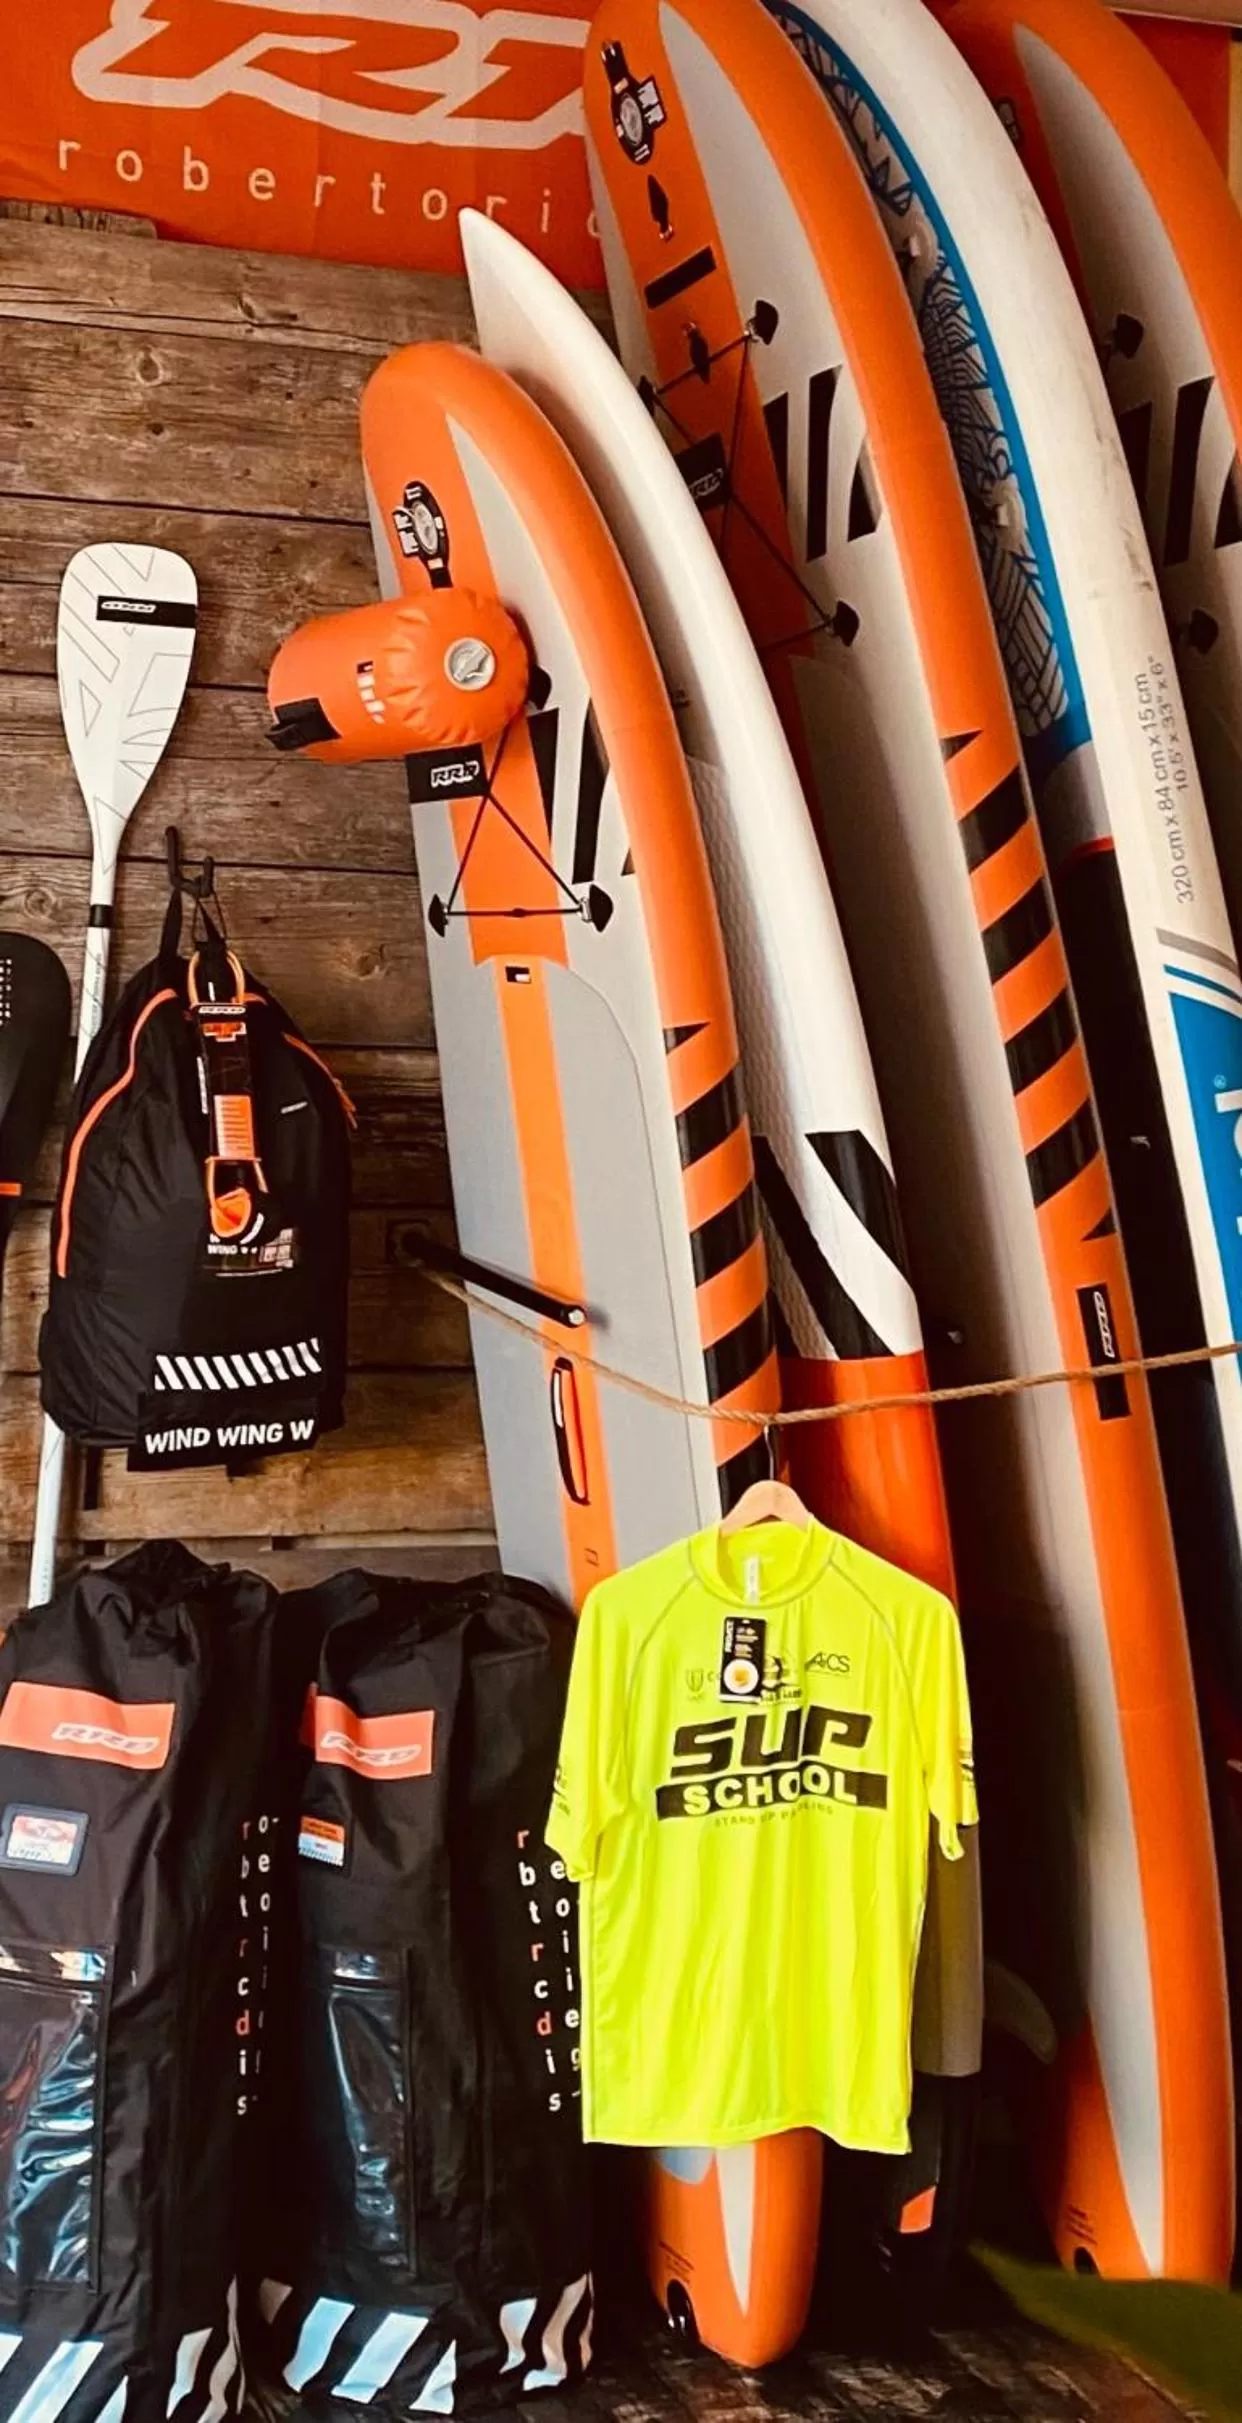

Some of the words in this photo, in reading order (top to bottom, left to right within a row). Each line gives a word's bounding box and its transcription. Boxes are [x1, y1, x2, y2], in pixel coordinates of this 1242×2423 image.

[1135, 672, 1152, 704] cm
[1138, 708, 1157, 732] 15
[1148, 734, 1162, 746] x
[1151, 750, 1168, 782] cm
[1155, 785, 1175, 811] 84
[1164, 815, 1179, 826] x
[1168, 830, 1185, 861] cm
[1171, 865, 1195, 904] 320
[145, 1427, 211, 1455] WIND
[216, 1422, 284, 1448] WING
[51, 1722, 160, 1755] RRD
[670, 1704, 873, 1779] SUP
[682, 1765, 858, 1815] SCHOOL
